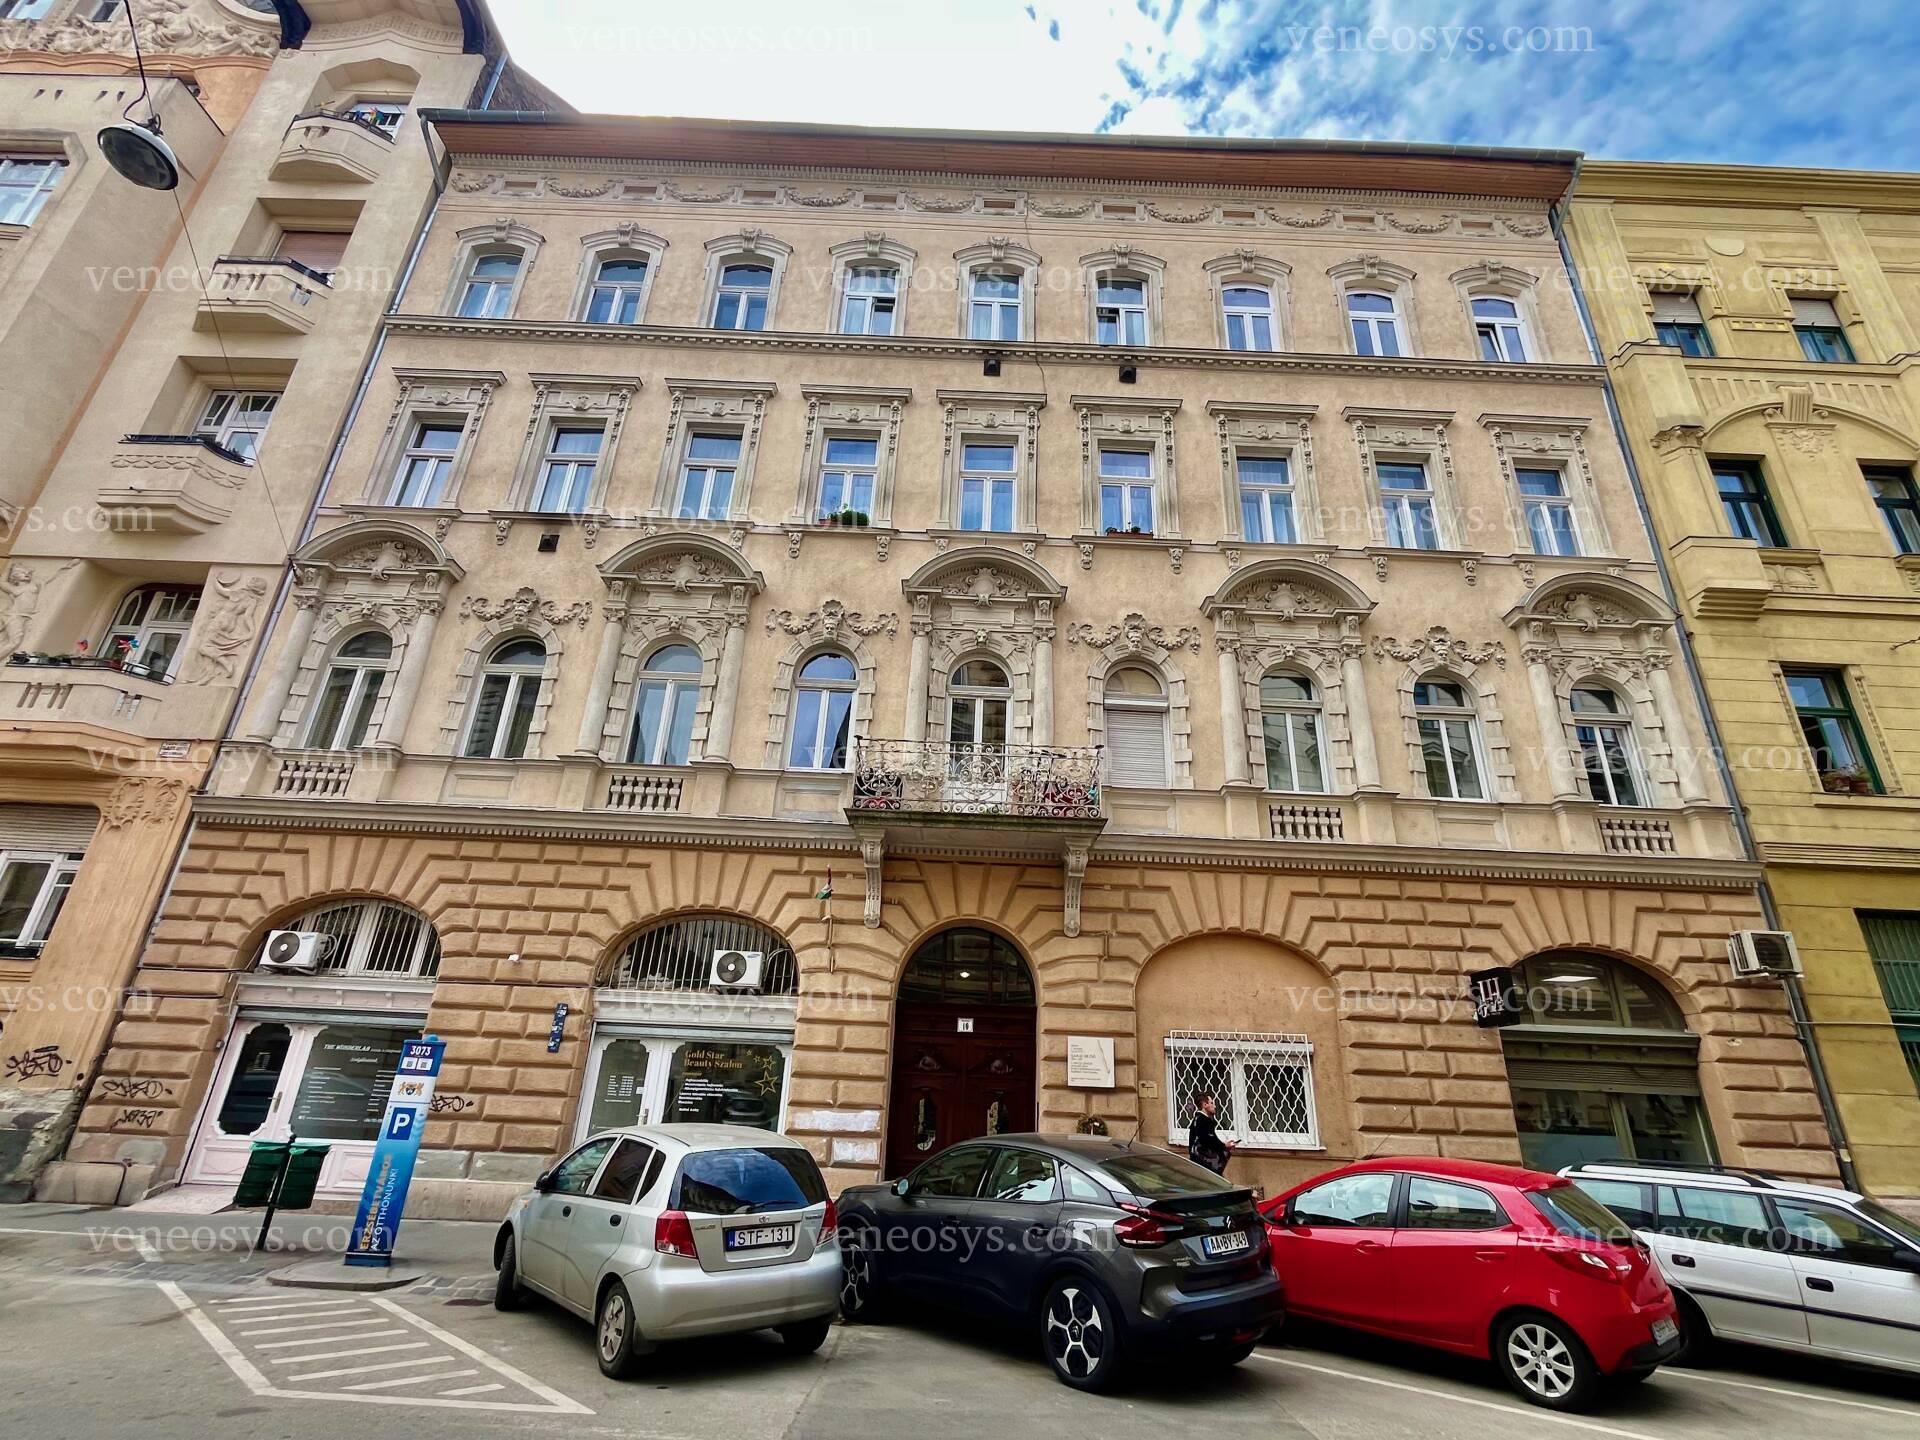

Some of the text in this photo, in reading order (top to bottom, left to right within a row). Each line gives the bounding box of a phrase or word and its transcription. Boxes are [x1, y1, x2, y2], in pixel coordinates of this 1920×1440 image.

[410, 1046, 431, 1056] 3073
[685, 1050, 725, 1060] Gold Star
[684, 1059, 743, 1069] Beauty Szalon
[392, 1113, 410, 1135] P
[370, 1168, 399, 1251] AZ OTTHONUNK!
[738, 1228, 790, 1246] STF-131
